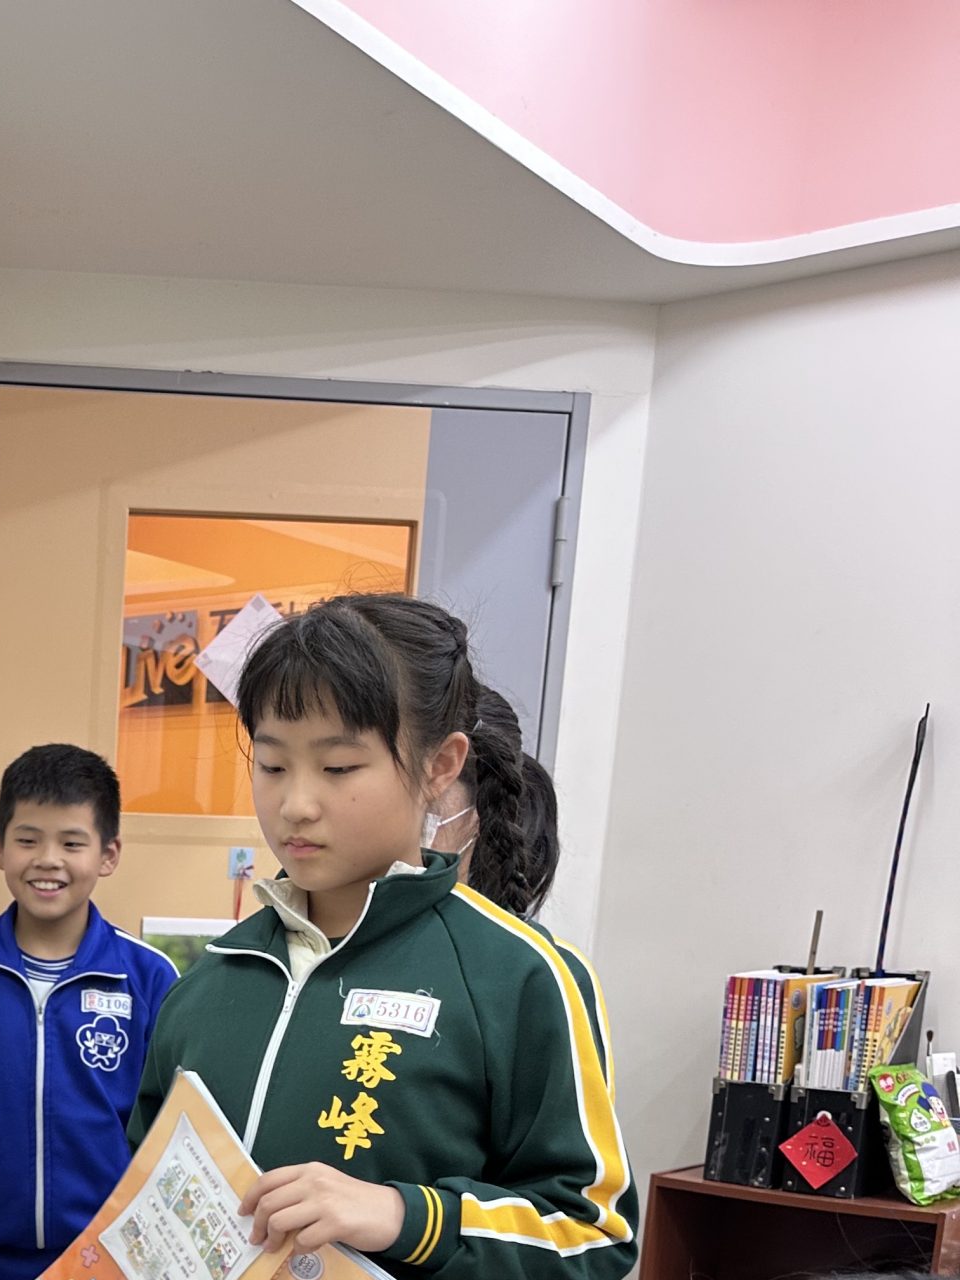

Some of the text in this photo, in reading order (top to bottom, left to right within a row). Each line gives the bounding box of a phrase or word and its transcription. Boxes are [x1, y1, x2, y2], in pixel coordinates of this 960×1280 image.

[97, 999, 129, 1011] 5106
[376, 1001, 426, 1023] 5316
[317, 1030, 403, 1161] 霧峰
[804, 1135, 836, 1167] 福
